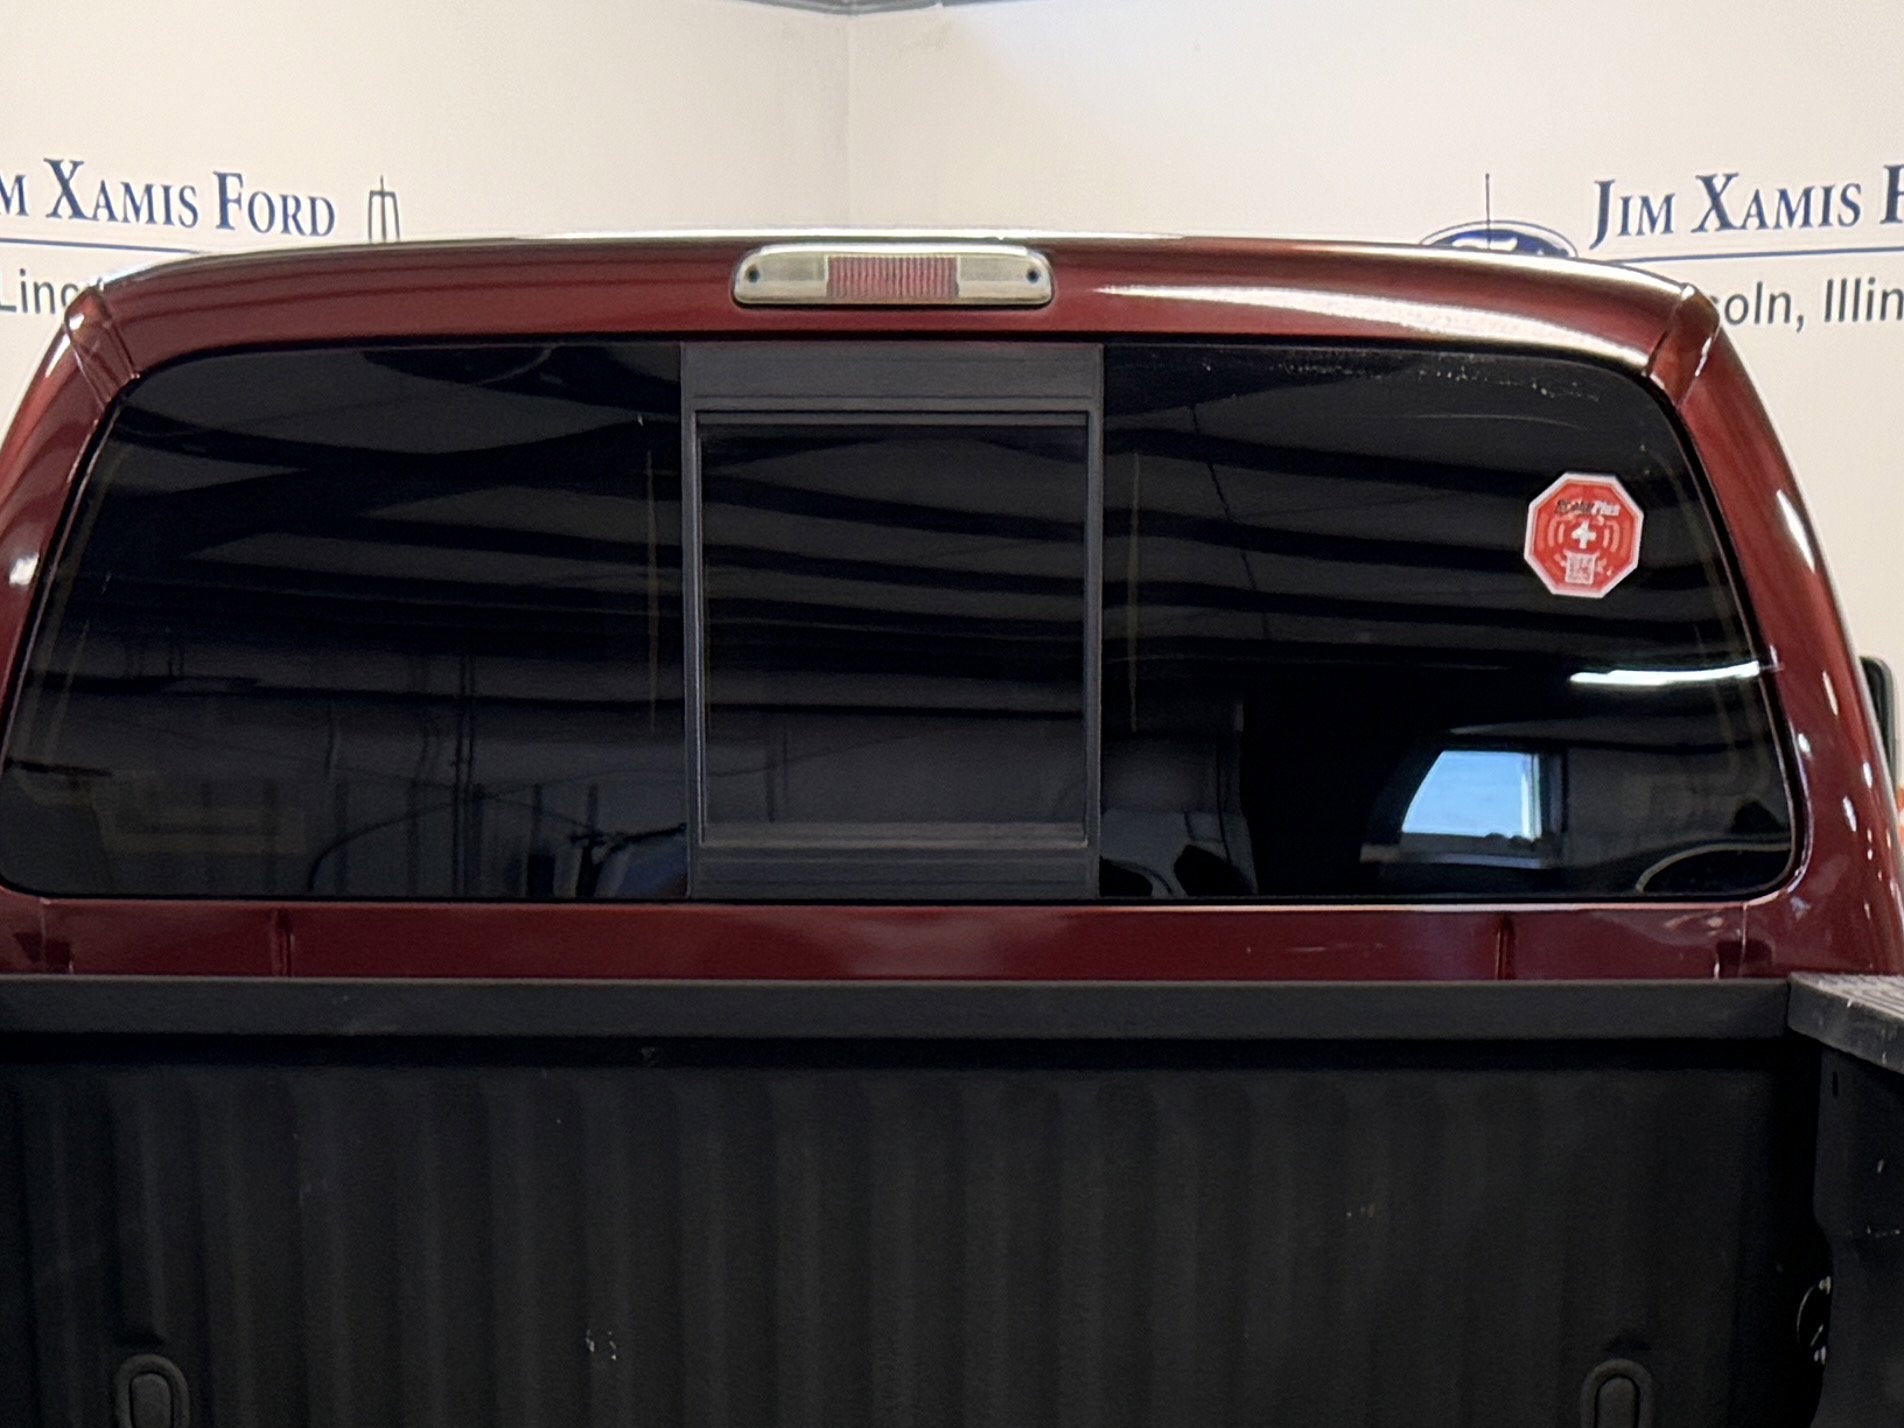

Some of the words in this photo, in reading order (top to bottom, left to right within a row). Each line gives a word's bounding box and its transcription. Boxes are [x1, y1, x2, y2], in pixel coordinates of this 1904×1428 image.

[43, 158, 198, 228] XAMIS
[213, 171, 335, 236] FORD
[1589, 179, 1675, 250] JIM
[1691, 173, 1861, 233] XAMIS
[1710, 281, 1804, 333] oln,
